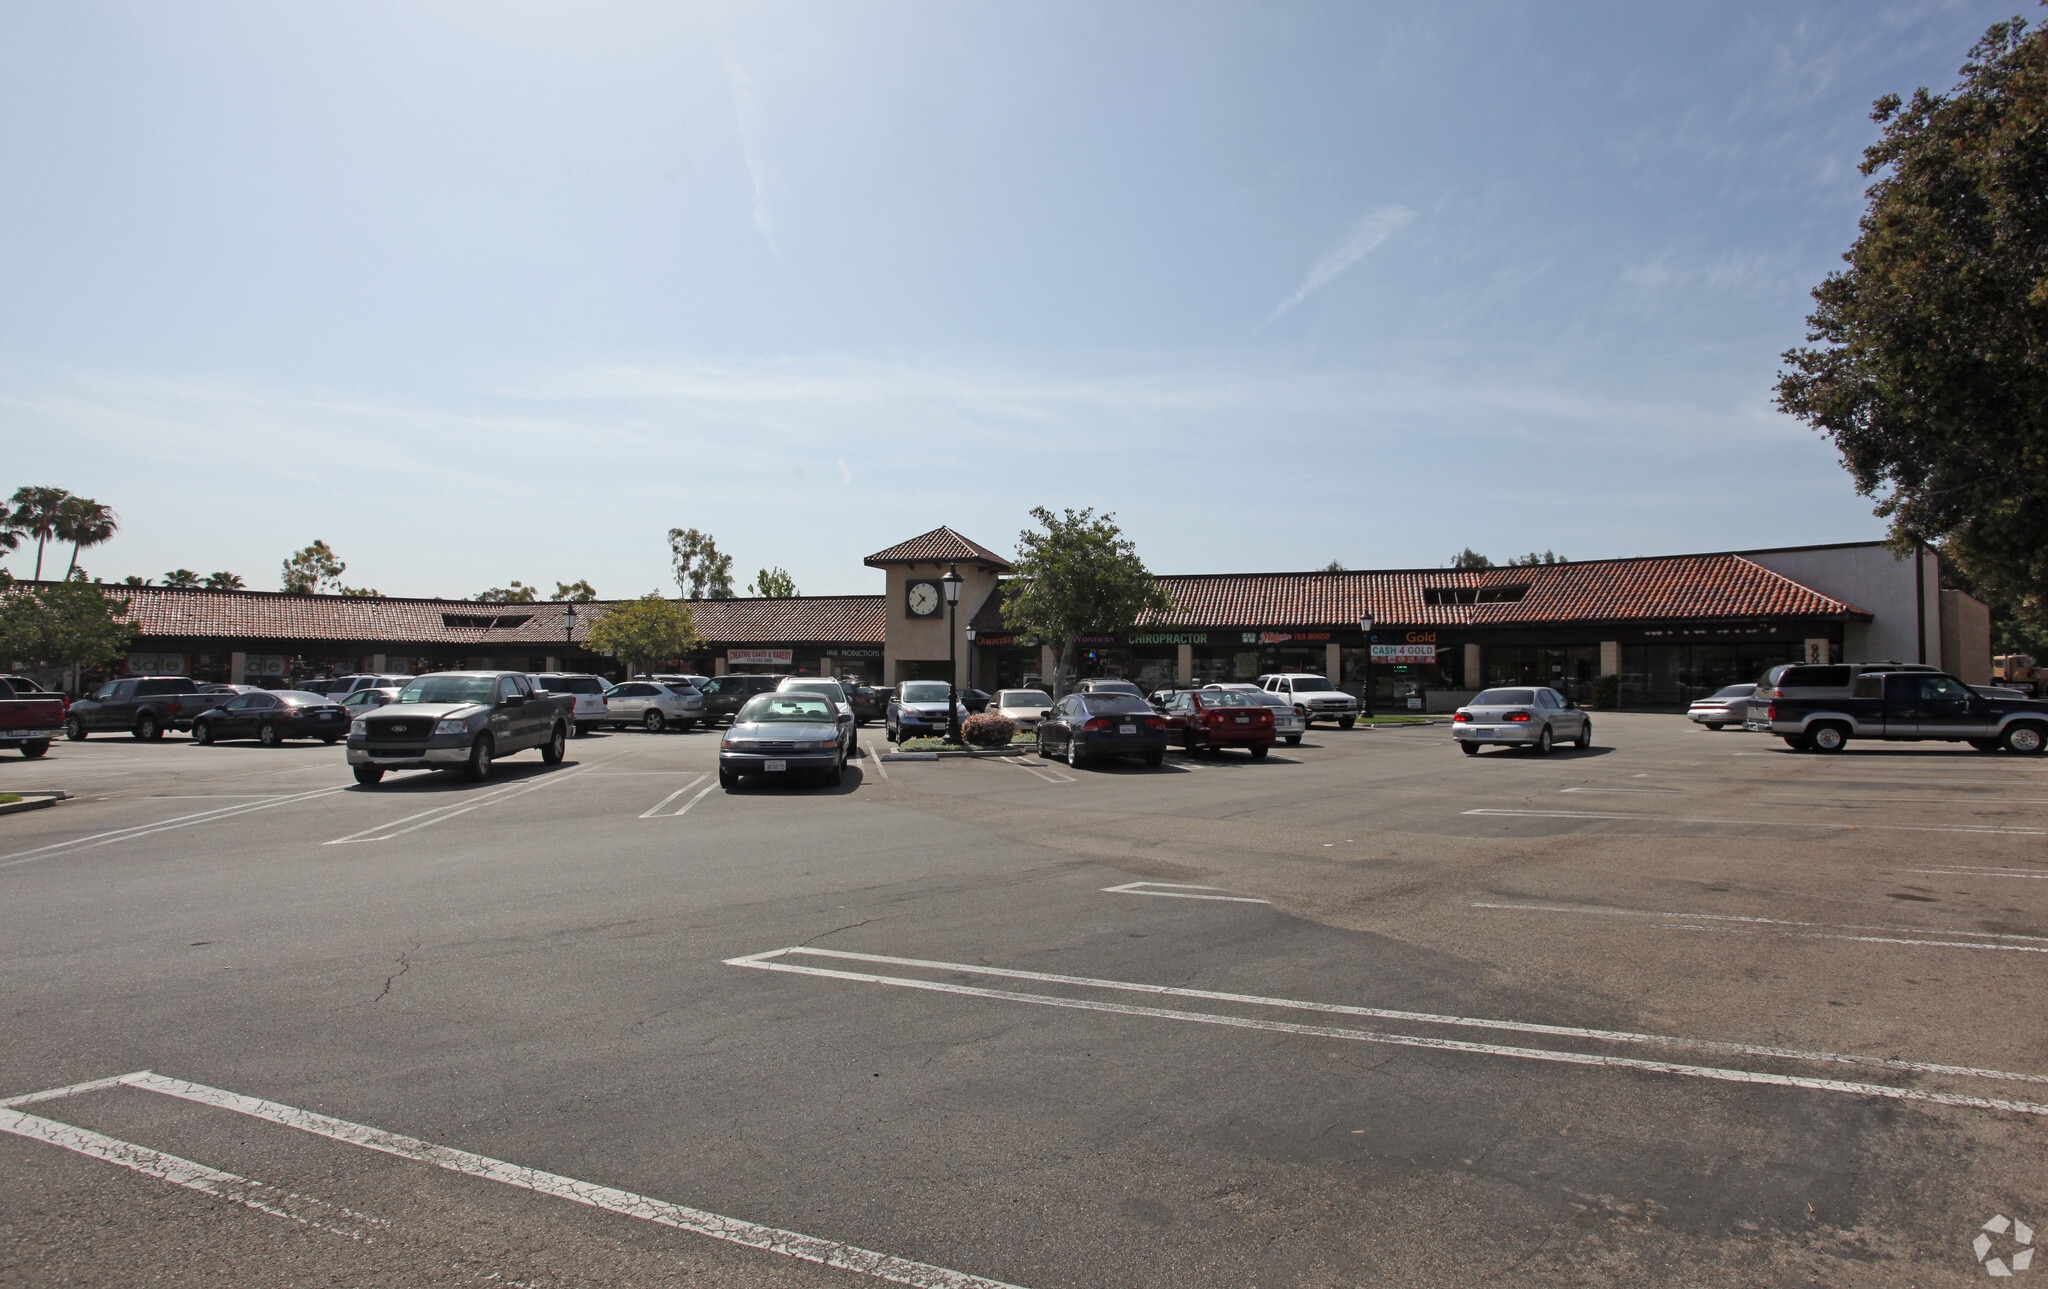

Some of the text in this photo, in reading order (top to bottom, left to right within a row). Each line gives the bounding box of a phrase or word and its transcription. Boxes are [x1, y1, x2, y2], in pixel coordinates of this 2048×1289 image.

[1128, 633, 1208, 645] CHIROPRACTOR
[1406, 631, 1436, 643] Gold
[841, 649, 880, 657] PRODUCTIONS
[1372, 646, 1433, 655] CASH 4 GOLD
[132, 658, 180, 672] sale
[245, 659, 281, 673] ale
